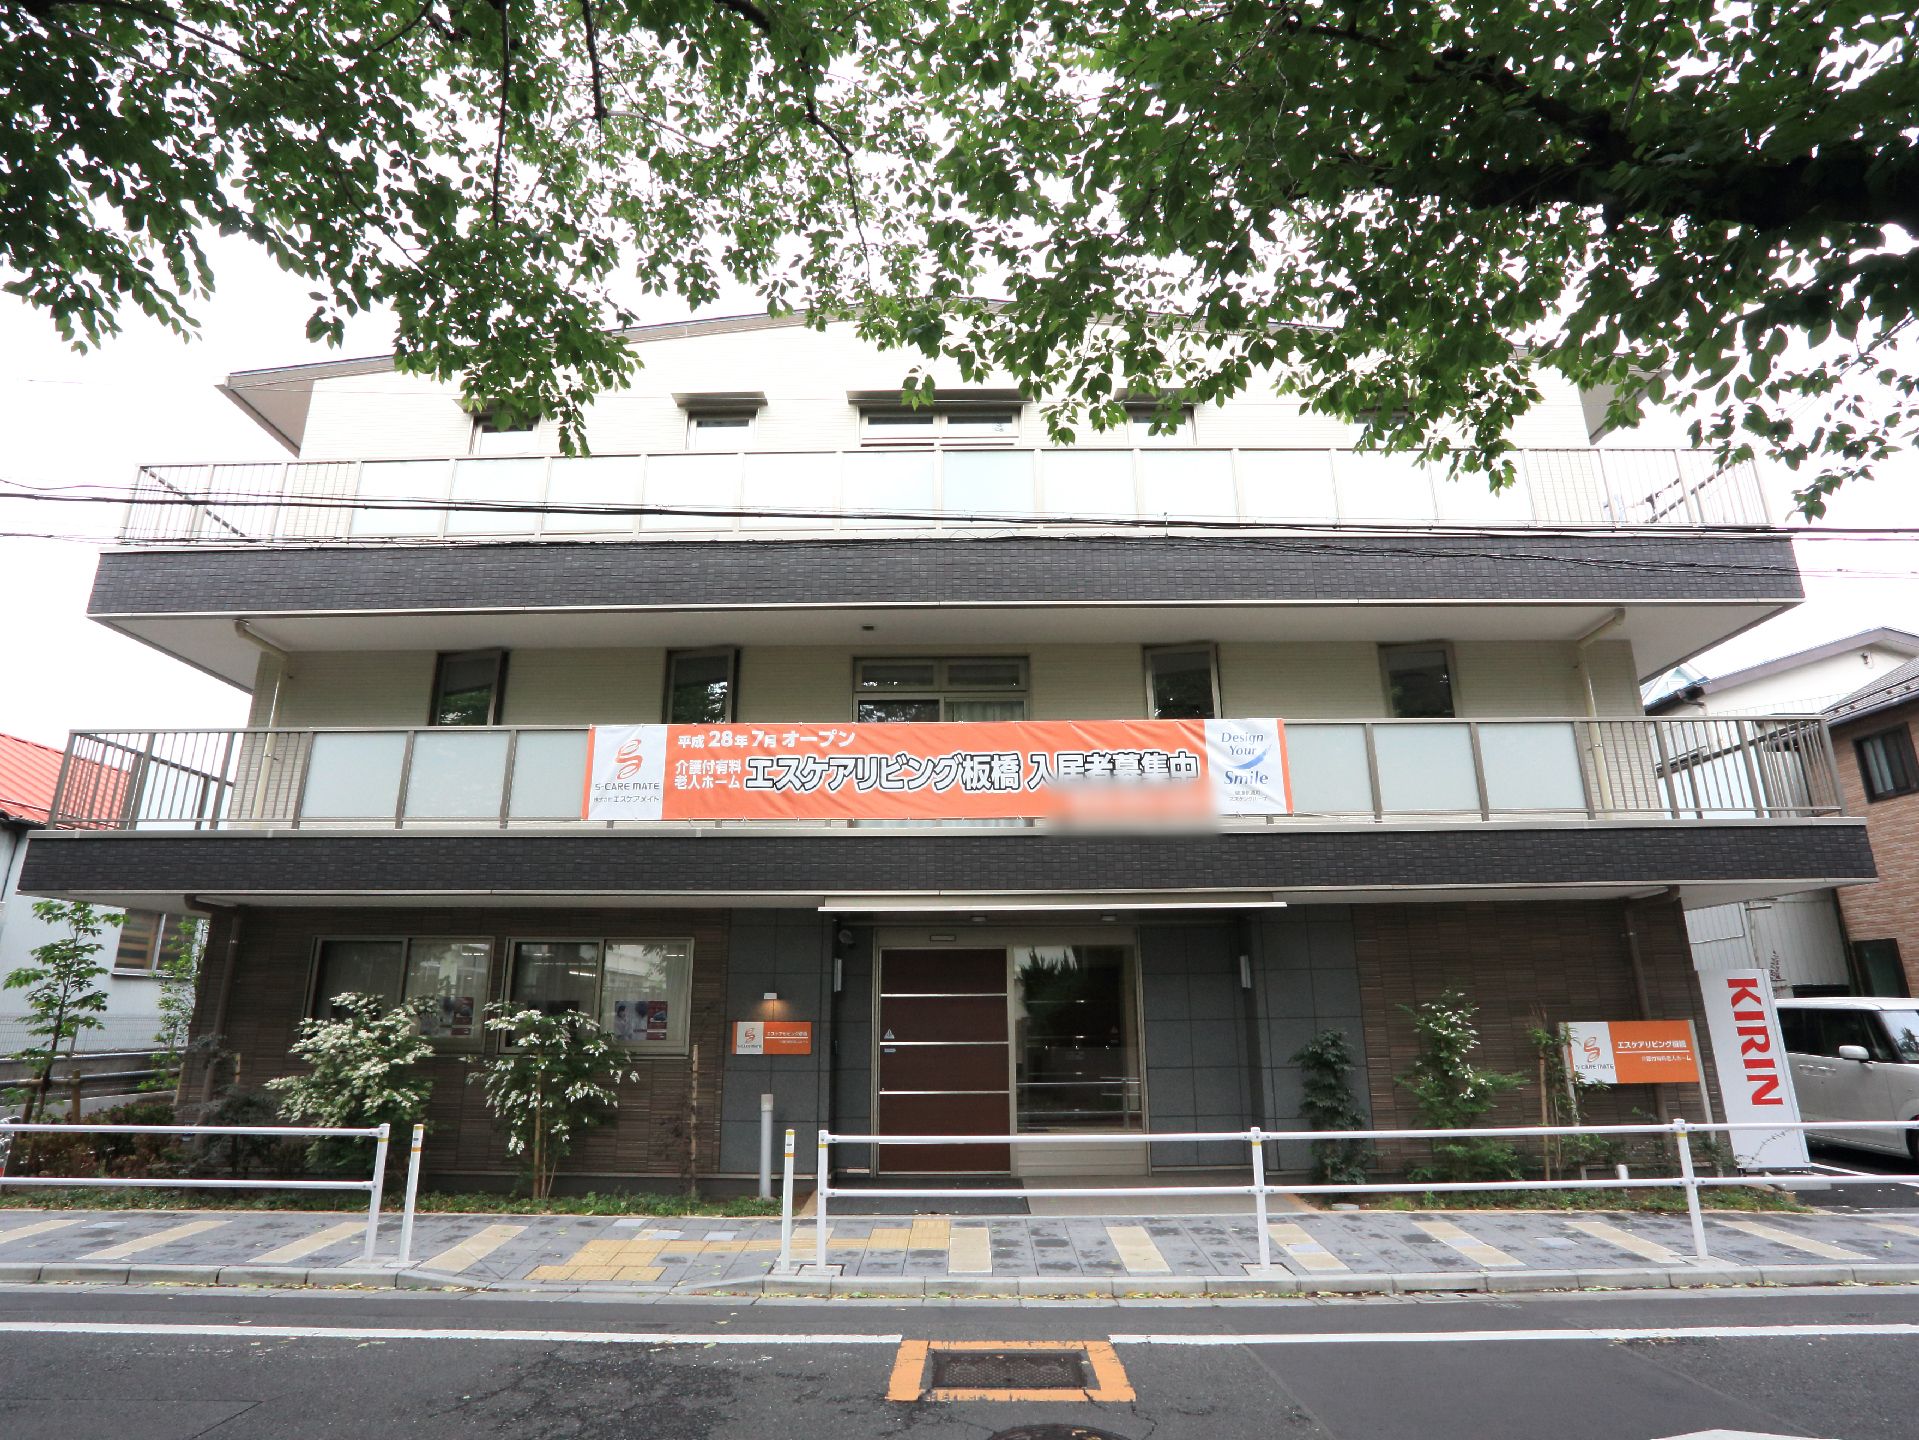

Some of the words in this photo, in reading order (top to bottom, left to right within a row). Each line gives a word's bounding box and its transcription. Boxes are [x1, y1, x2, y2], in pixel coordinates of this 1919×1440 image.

[1221, 731, 1264, 745] Design
[1229, 745, 1257, 756] Your
[675, 759, 742, 774] 介護付有料
[744, 752, 1022, 792] エスケアリビング板橋
[674, 775, 742, 790] 老人ホーム
[1223, 770, 1269, 785] Smile
[594, 782, 631, 791] S-CARE
[632, 782, 660, 790] MATE
[1726, 978, 1784, 1106] KIRIN
